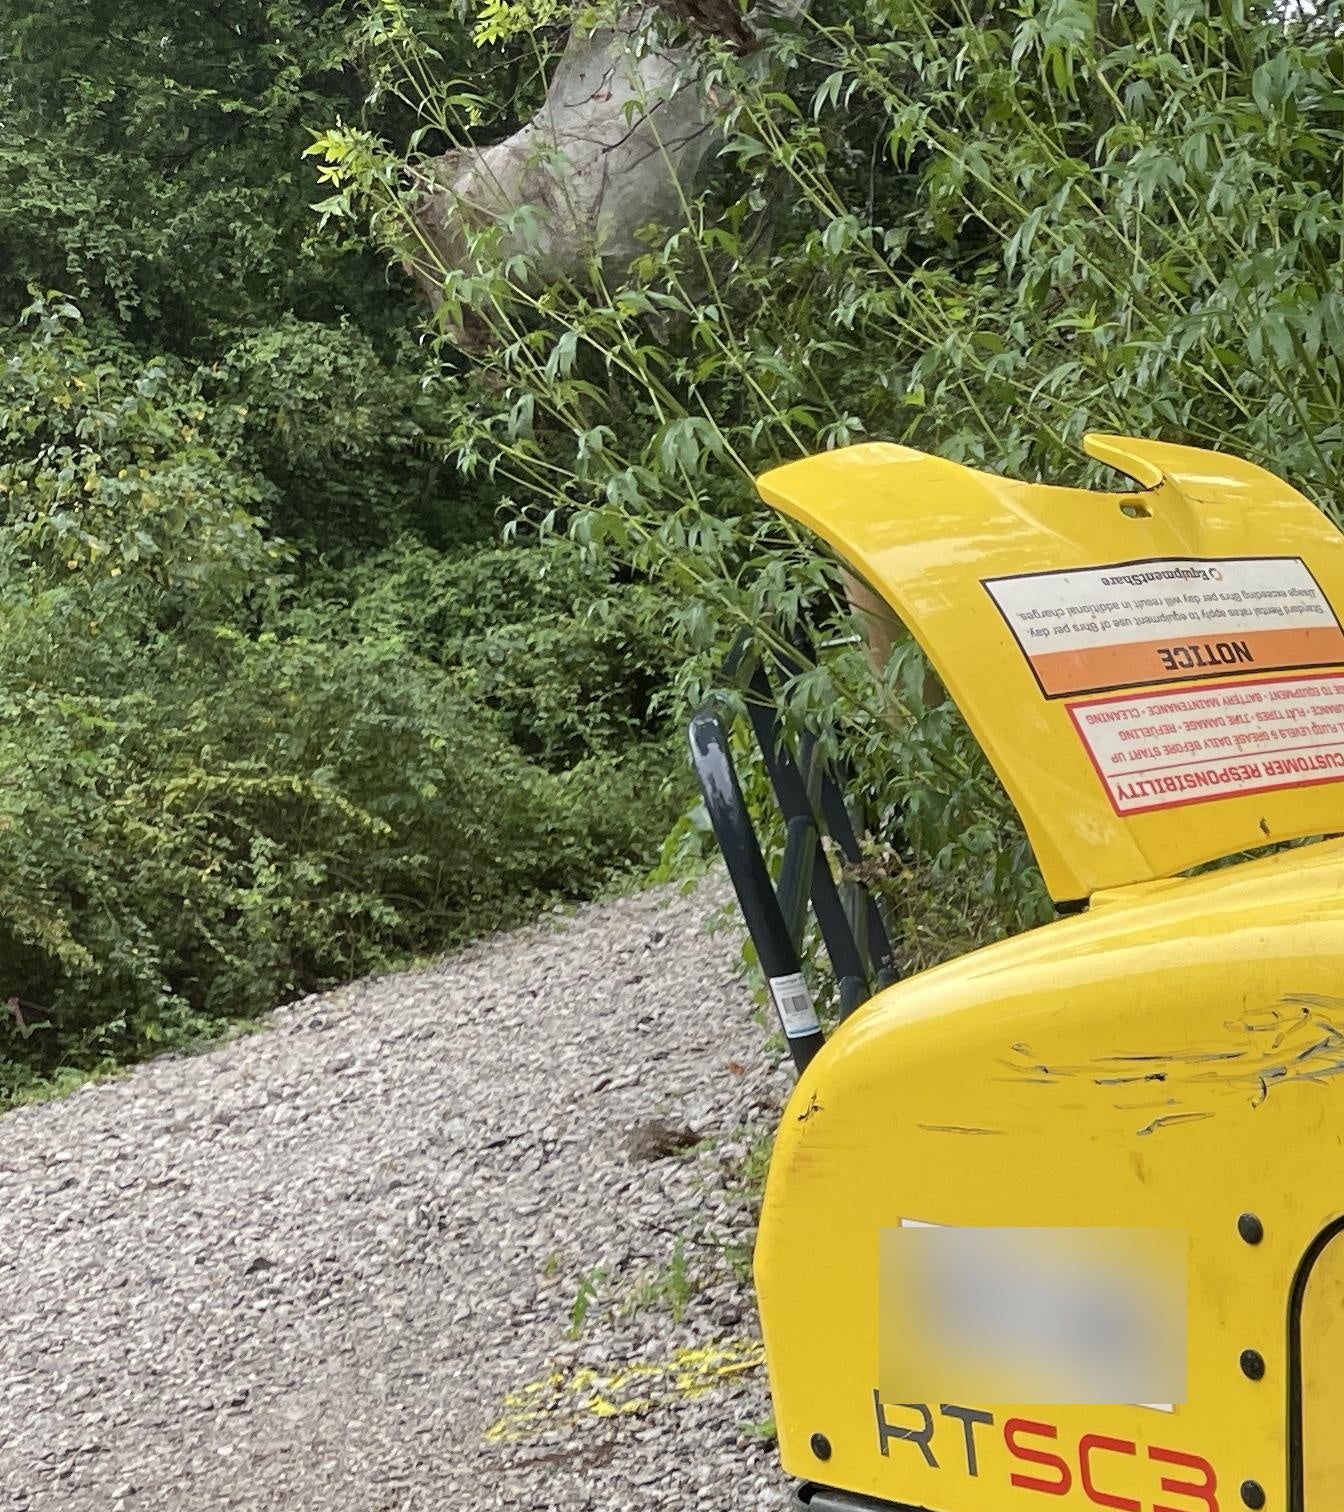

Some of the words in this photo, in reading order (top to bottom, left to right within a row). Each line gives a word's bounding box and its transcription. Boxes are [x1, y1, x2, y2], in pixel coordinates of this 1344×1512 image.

[1100, 568, 1210, 587] EquipmentShare
[1163, 596, 1181, 606] will
[1183, 594, 1200, 604] day
[1203, 592, 1218, 602] per
[1066, 602, 1120, 617] additional
[1131, 598, 1163, 609] result
[1016, 608, 1065, 621] charges.
[1133, 611, 1187, 626] equipment
[1189, 612, 1199, 620] to
[1201, 608, 1226, 620] apply
[1227, 608, 1252, 617] rates
[1053, 624, 1071, 635] per
[1100, 620, 1111, 631] of
[1112, 619, 1132, 628] use
[1027, 627, 1049, 638] day.
[1157, 641, 1254, 670] NOTICE
[1269, 687, 1319, 701] EQUIPMENT
[1321, 686, 1333, 696] TO
[1221, 693, 1262, 706] BATTERY
[1147, 697, 1220, 717] MAINTENANCE
[1085, 708, 1140, 725] CLEANING
[1225, 713, 1250, 725] TIRE
[1255, 711, 1284, 722] TIRES
[1285, 707, 1306, 720] FLAT
[1183, 717, 1225, 731] DAMAGE
[1311, 724, 1337, 734] FLUID
[1118, 724, 1177, 741] REFUELING
[1233, 731, 1270, 745] GREASE
[1279, 727, 1310, 738] LEVELS
[1162, 741, 1202, 755] BEFORE
[1203, 737, 1232, 749] DAILY
[1111, 752, 1127, 763] UP
[1128, 747, 1161, 760] START
[1116, 764, 1260, 800] RESPONSIBILITY
